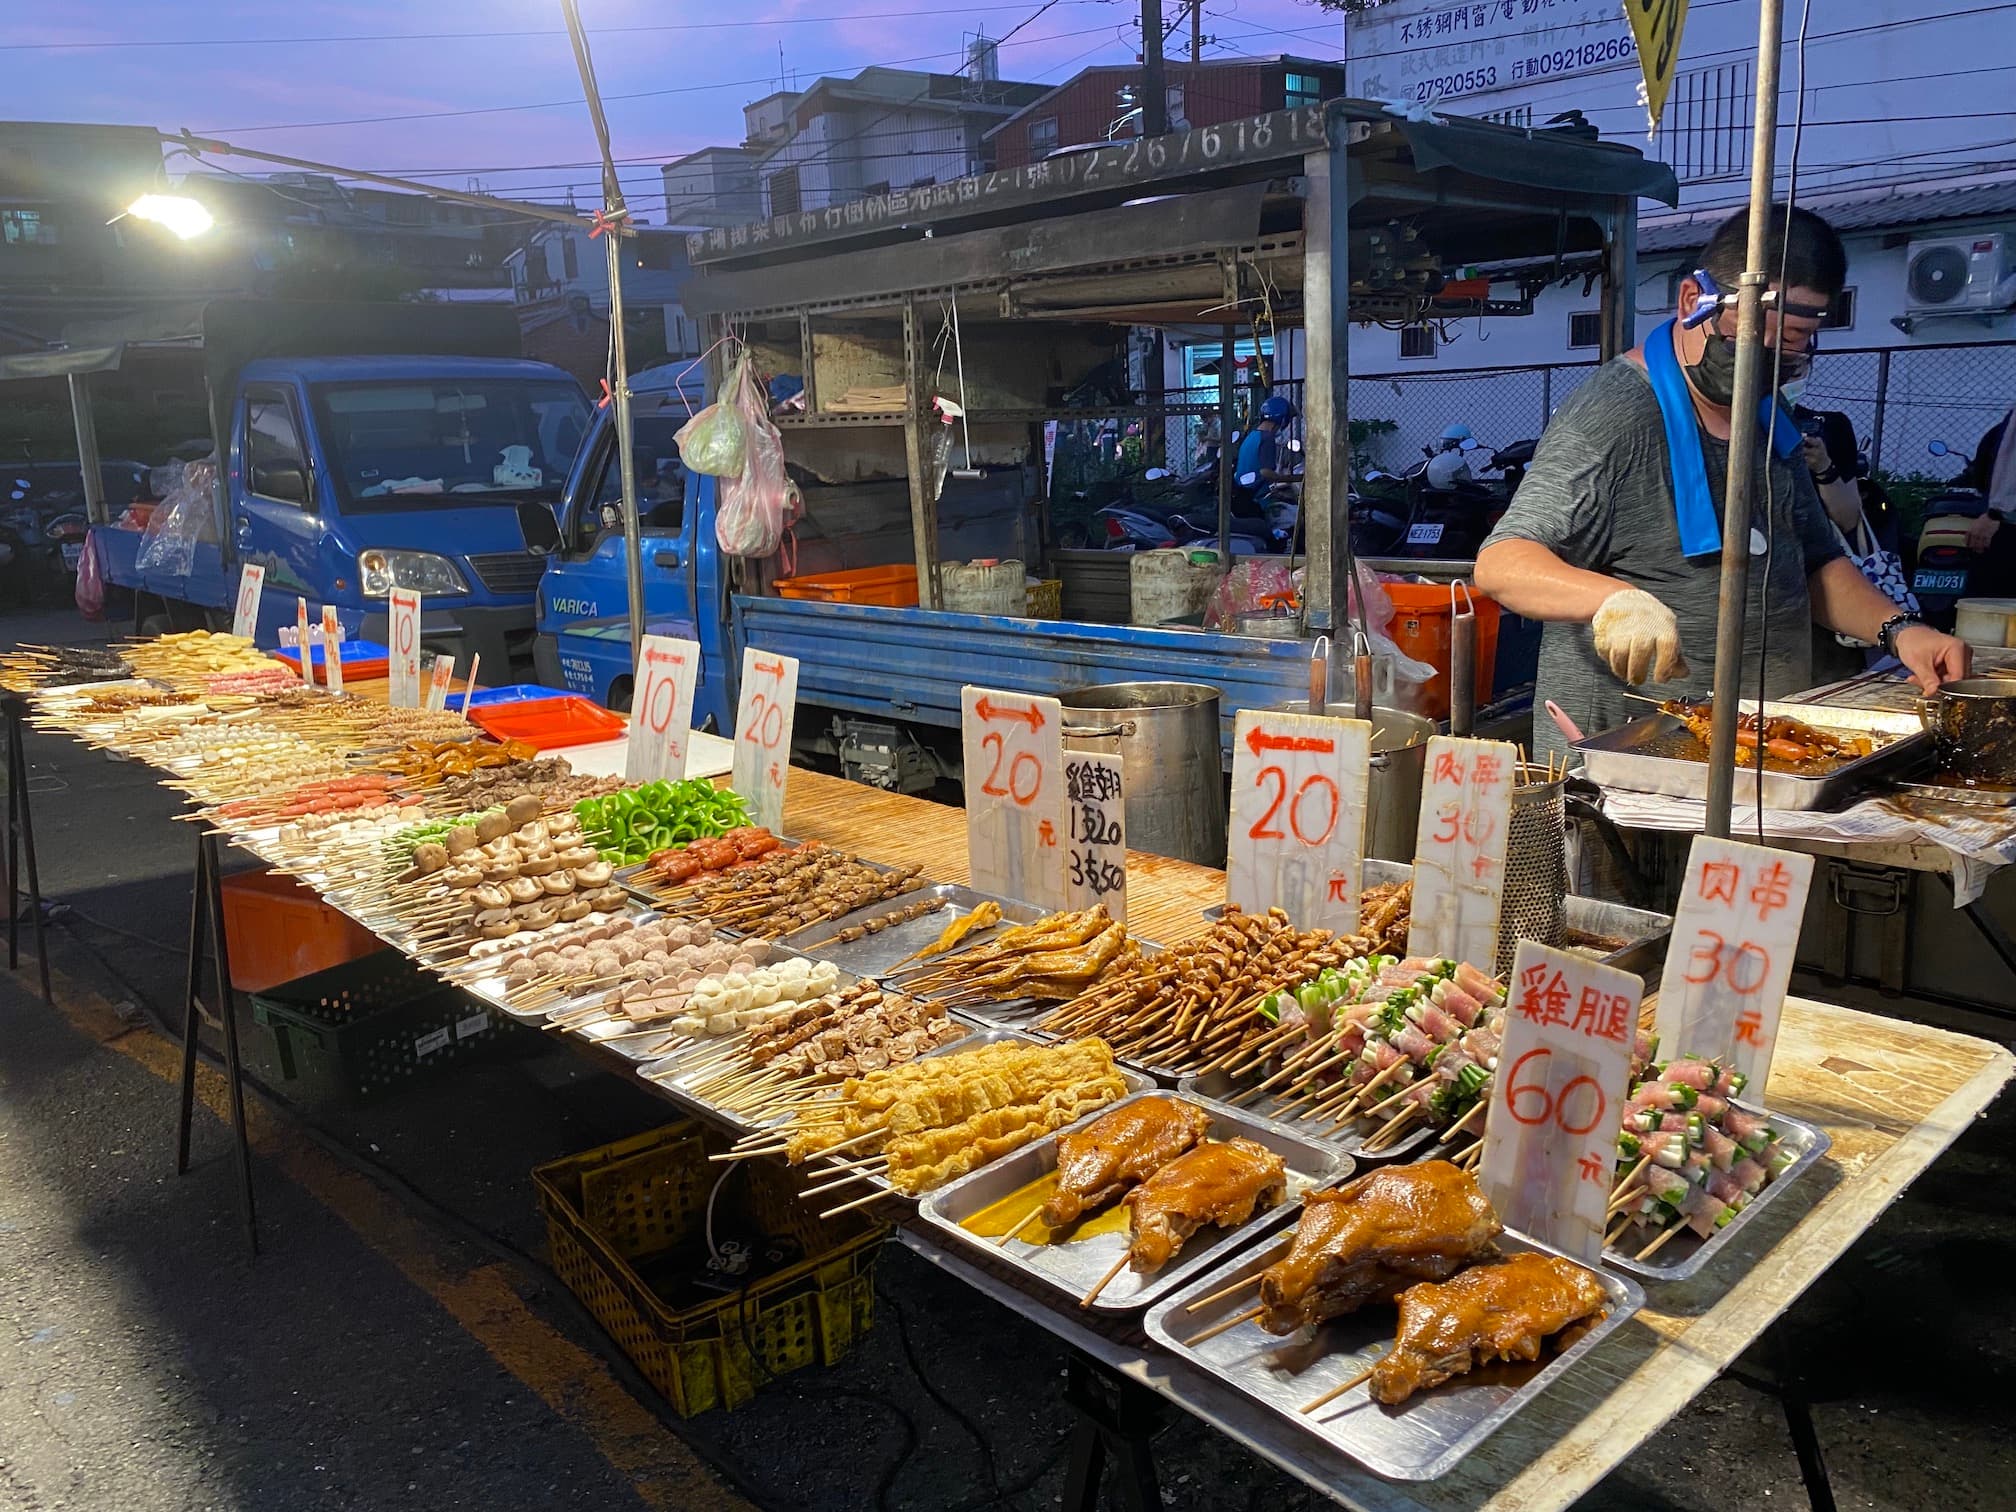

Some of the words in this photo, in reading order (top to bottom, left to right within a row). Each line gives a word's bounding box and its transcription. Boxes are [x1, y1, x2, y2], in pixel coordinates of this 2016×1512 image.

[395, 611, 413, 655] 10
[553, 597, 598, 617] VARICA
[640, 670, 676, 734] 10
[744, 693, 783, 749] 20
[981, 731, 1043, 806] 20
[1038, 819, 1057, 847] 元
[1248, 765, 1340, 846] 20
[1432, 801, 1496, 846] 30
[1327, 868, 1348, 903] 元
[1697, 857, 1794, 922] 肉串
[1682, 929, 1771, 995] 30
[1515, 962, 1632, 1045] 雞腿
[1734, 1010, 1766, 1049] 元
[1505, 1048, 1607, 1136] 60
[1577, 1151, 1606, 1188] 元
